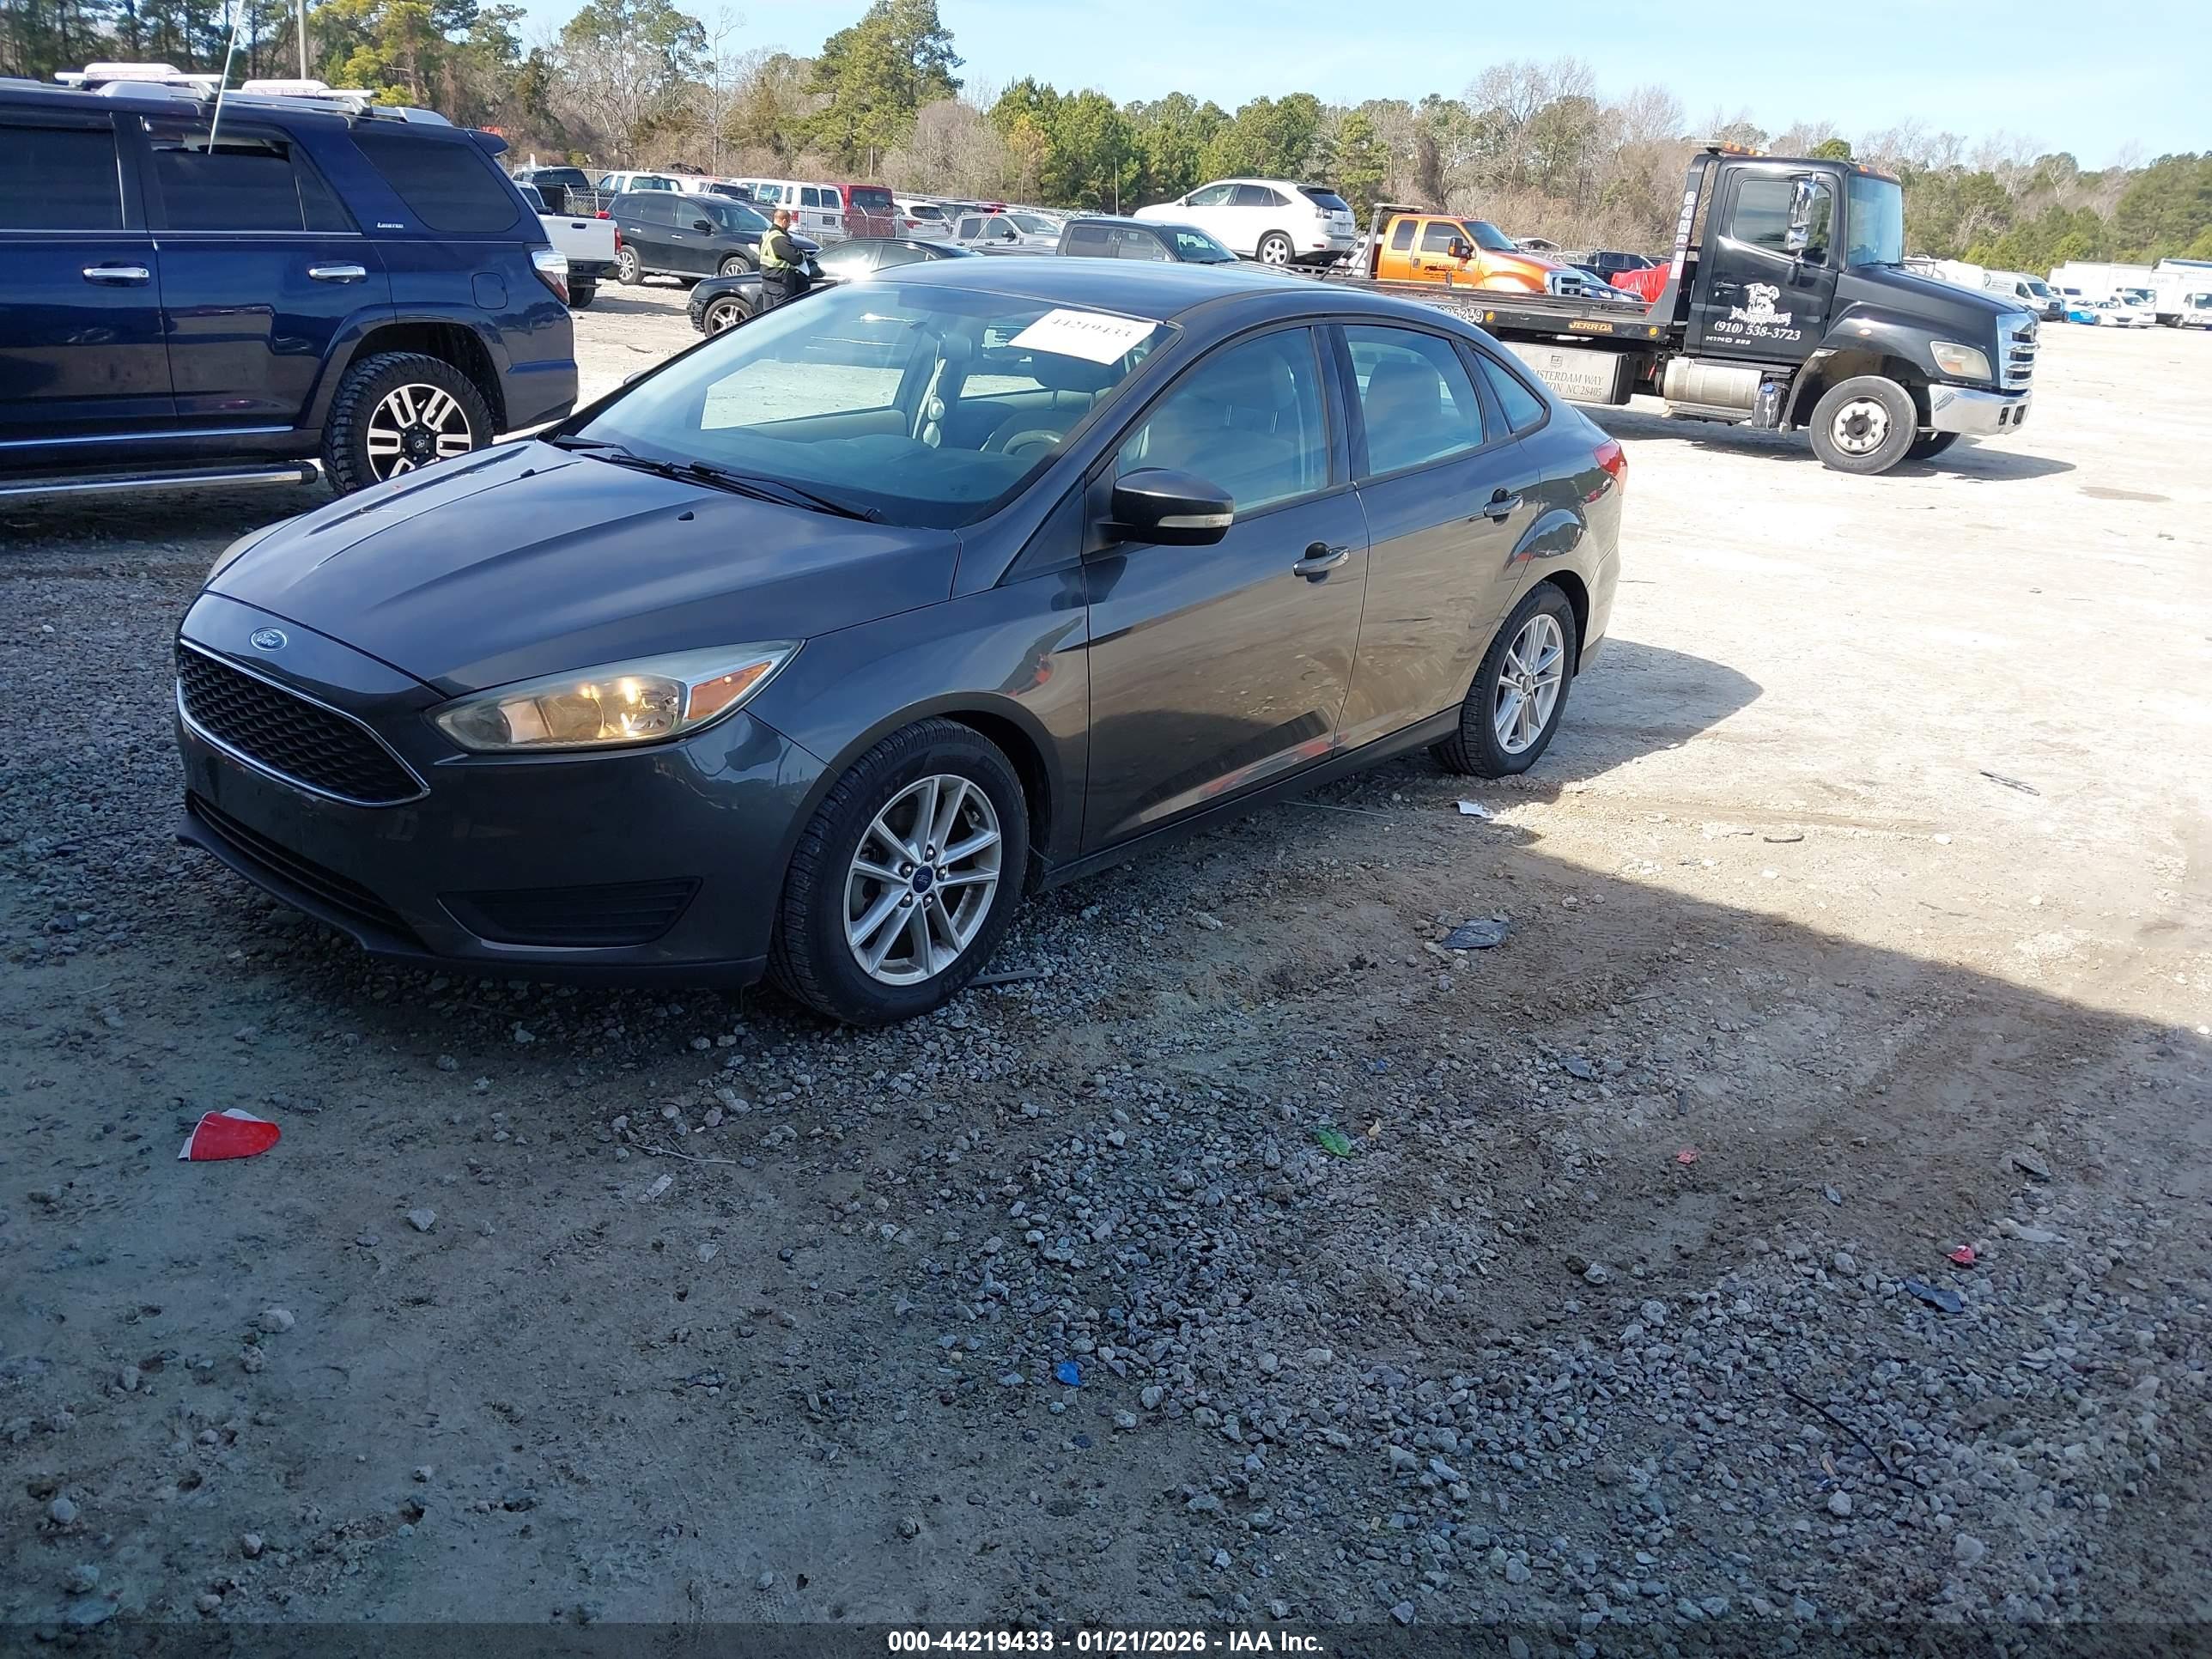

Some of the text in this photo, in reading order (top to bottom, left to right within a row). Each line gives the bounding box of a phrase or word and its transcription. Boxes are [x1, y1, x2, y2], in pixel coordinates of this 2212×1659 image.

[1714, 320, 1802, 341] (910) 538-3723
[1705, 335, 1733, 343] HINO
[1584, 374, 1603, 386] WAY
[1566, 384, 1579, 395] NC
